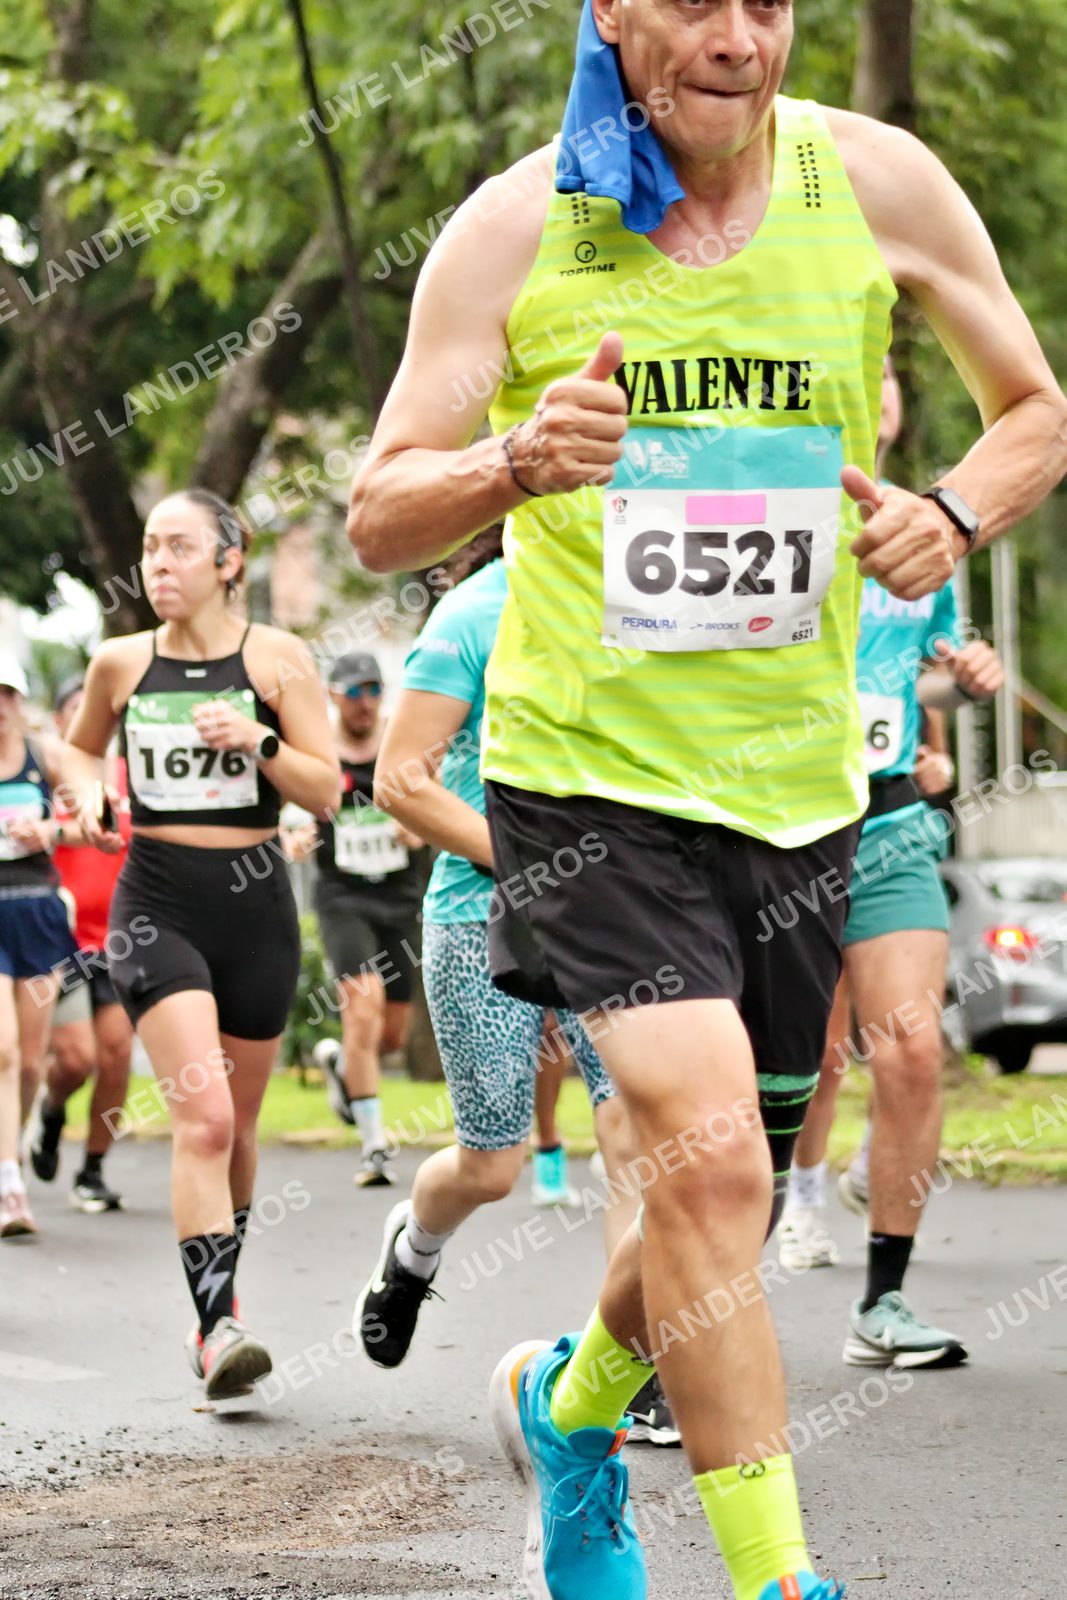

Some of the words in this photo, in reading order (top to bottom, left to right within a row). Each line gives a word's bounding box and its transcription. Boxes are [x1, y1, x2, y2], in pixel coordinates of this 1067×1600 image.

[559, 263, 616, 277] TOPTIME
[613, 357, 811, 416] VALENTE
[625, 529, 813, 597] 6521
[621, 616, 677, 630] PERDURA
[704, 622, 740, 631] BROOKS
[791, 628, 814, 641] 6521
[867, 719, 891, 751] 6
[139, 747, 247, 780] 1676
